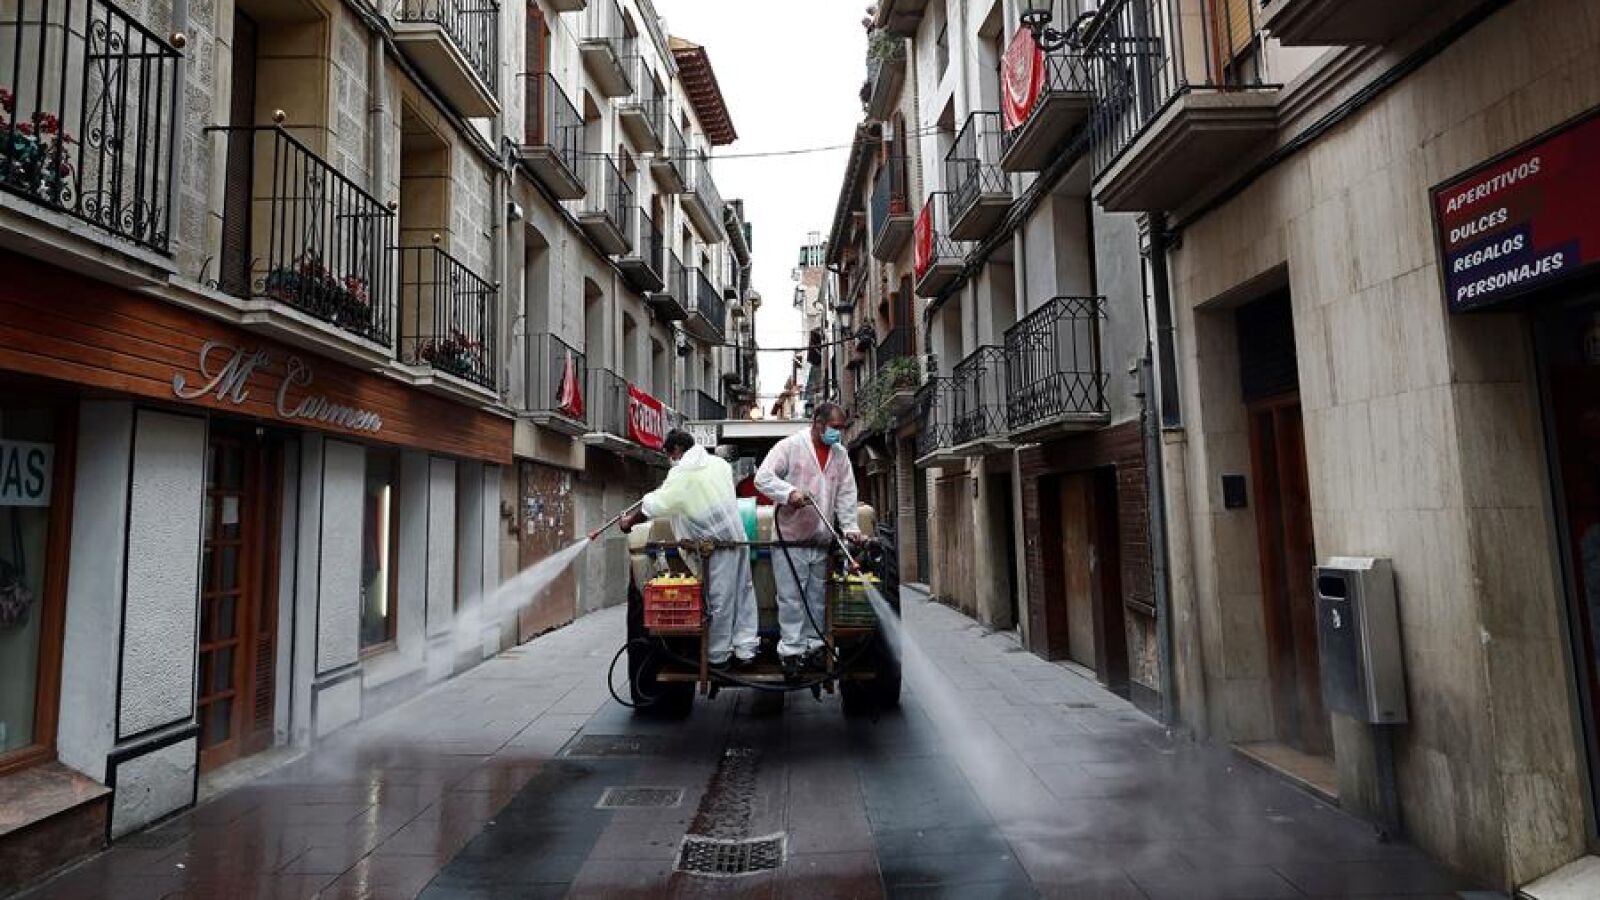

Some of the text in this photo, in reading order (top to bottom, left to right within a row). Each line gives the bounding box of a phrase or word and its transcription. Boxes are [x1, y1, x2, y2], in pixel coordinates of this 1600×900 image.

[1446, 157, 1541, 213] APERITIVOS
[1450, 207, 1508, 243] DULCES
[1454, 234, 1525, 273] REGALOS
[1457, 252, 1564, 301] PERSONAJES
[276, 355, 383, 433] Carmen
[0, 446, 46, 499] AS
